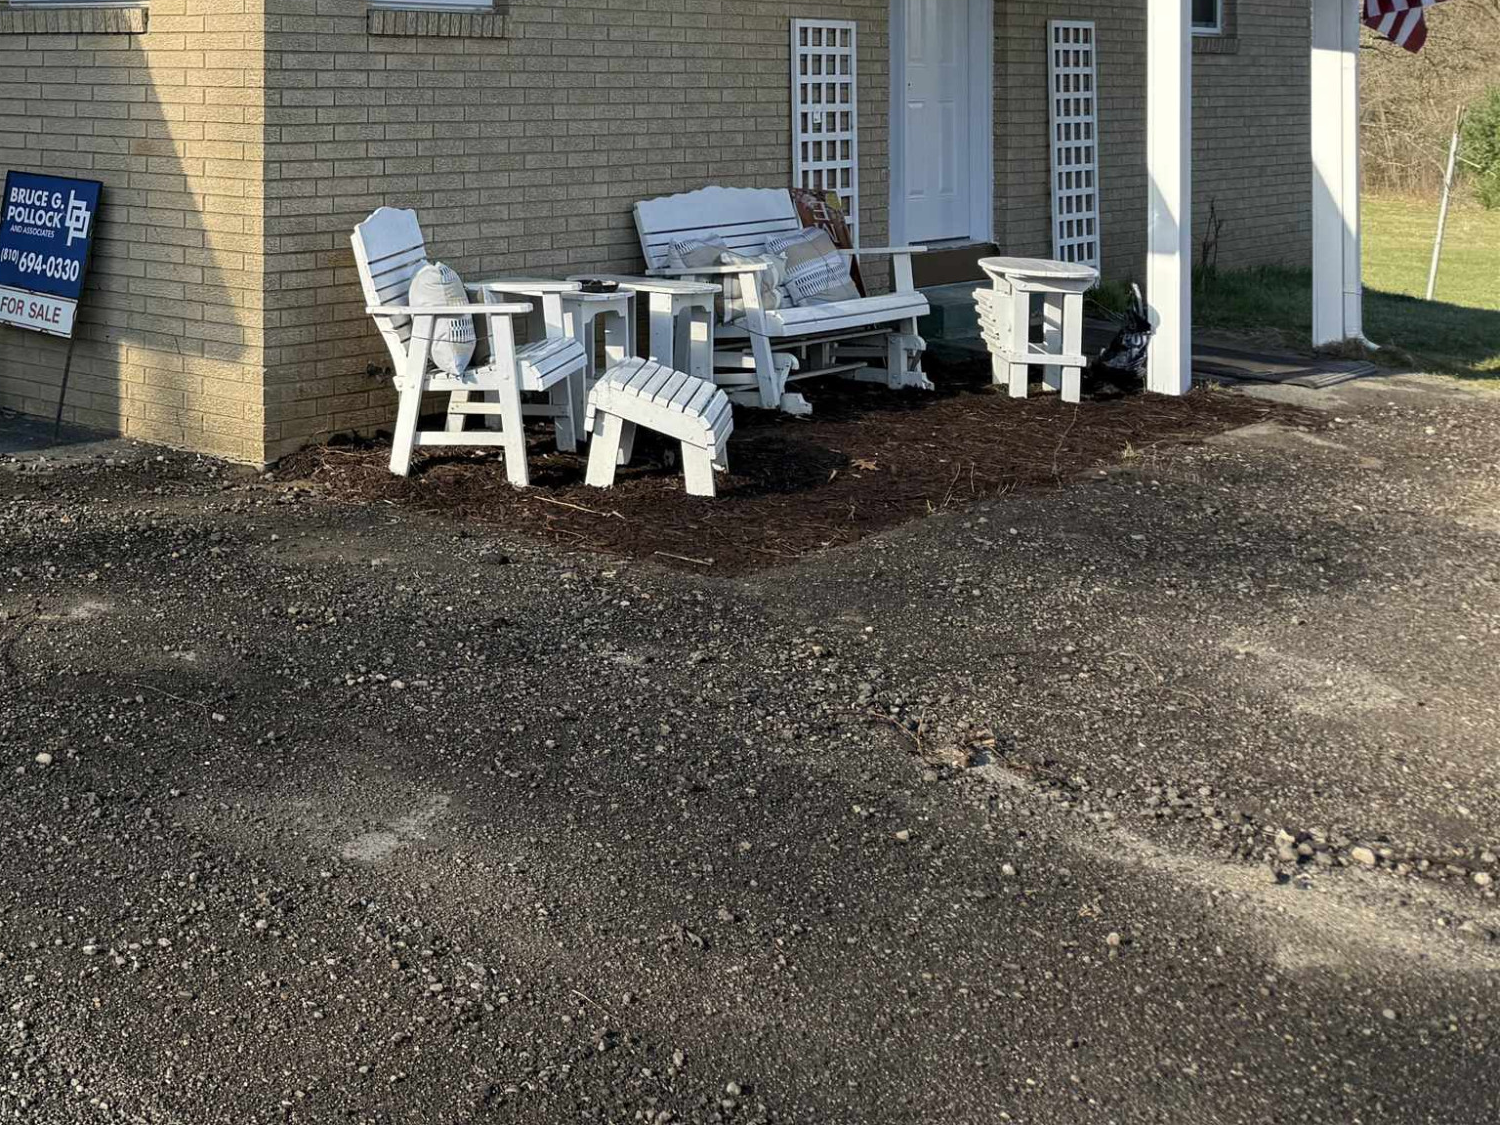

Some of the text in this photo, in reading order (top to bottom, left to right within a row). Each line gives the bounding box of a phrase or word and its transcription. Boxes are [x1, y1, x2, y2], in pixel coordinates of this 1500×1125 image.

[10, 187, 65, 209] BRUCE G.
[7, 206, 62, 228] POLLOCK
[10, 225, 55, 238] AND ASSOCIATES
[18, 252, 80, 282] 694-0330
[0, 296, 62, 323] FOR SALE
